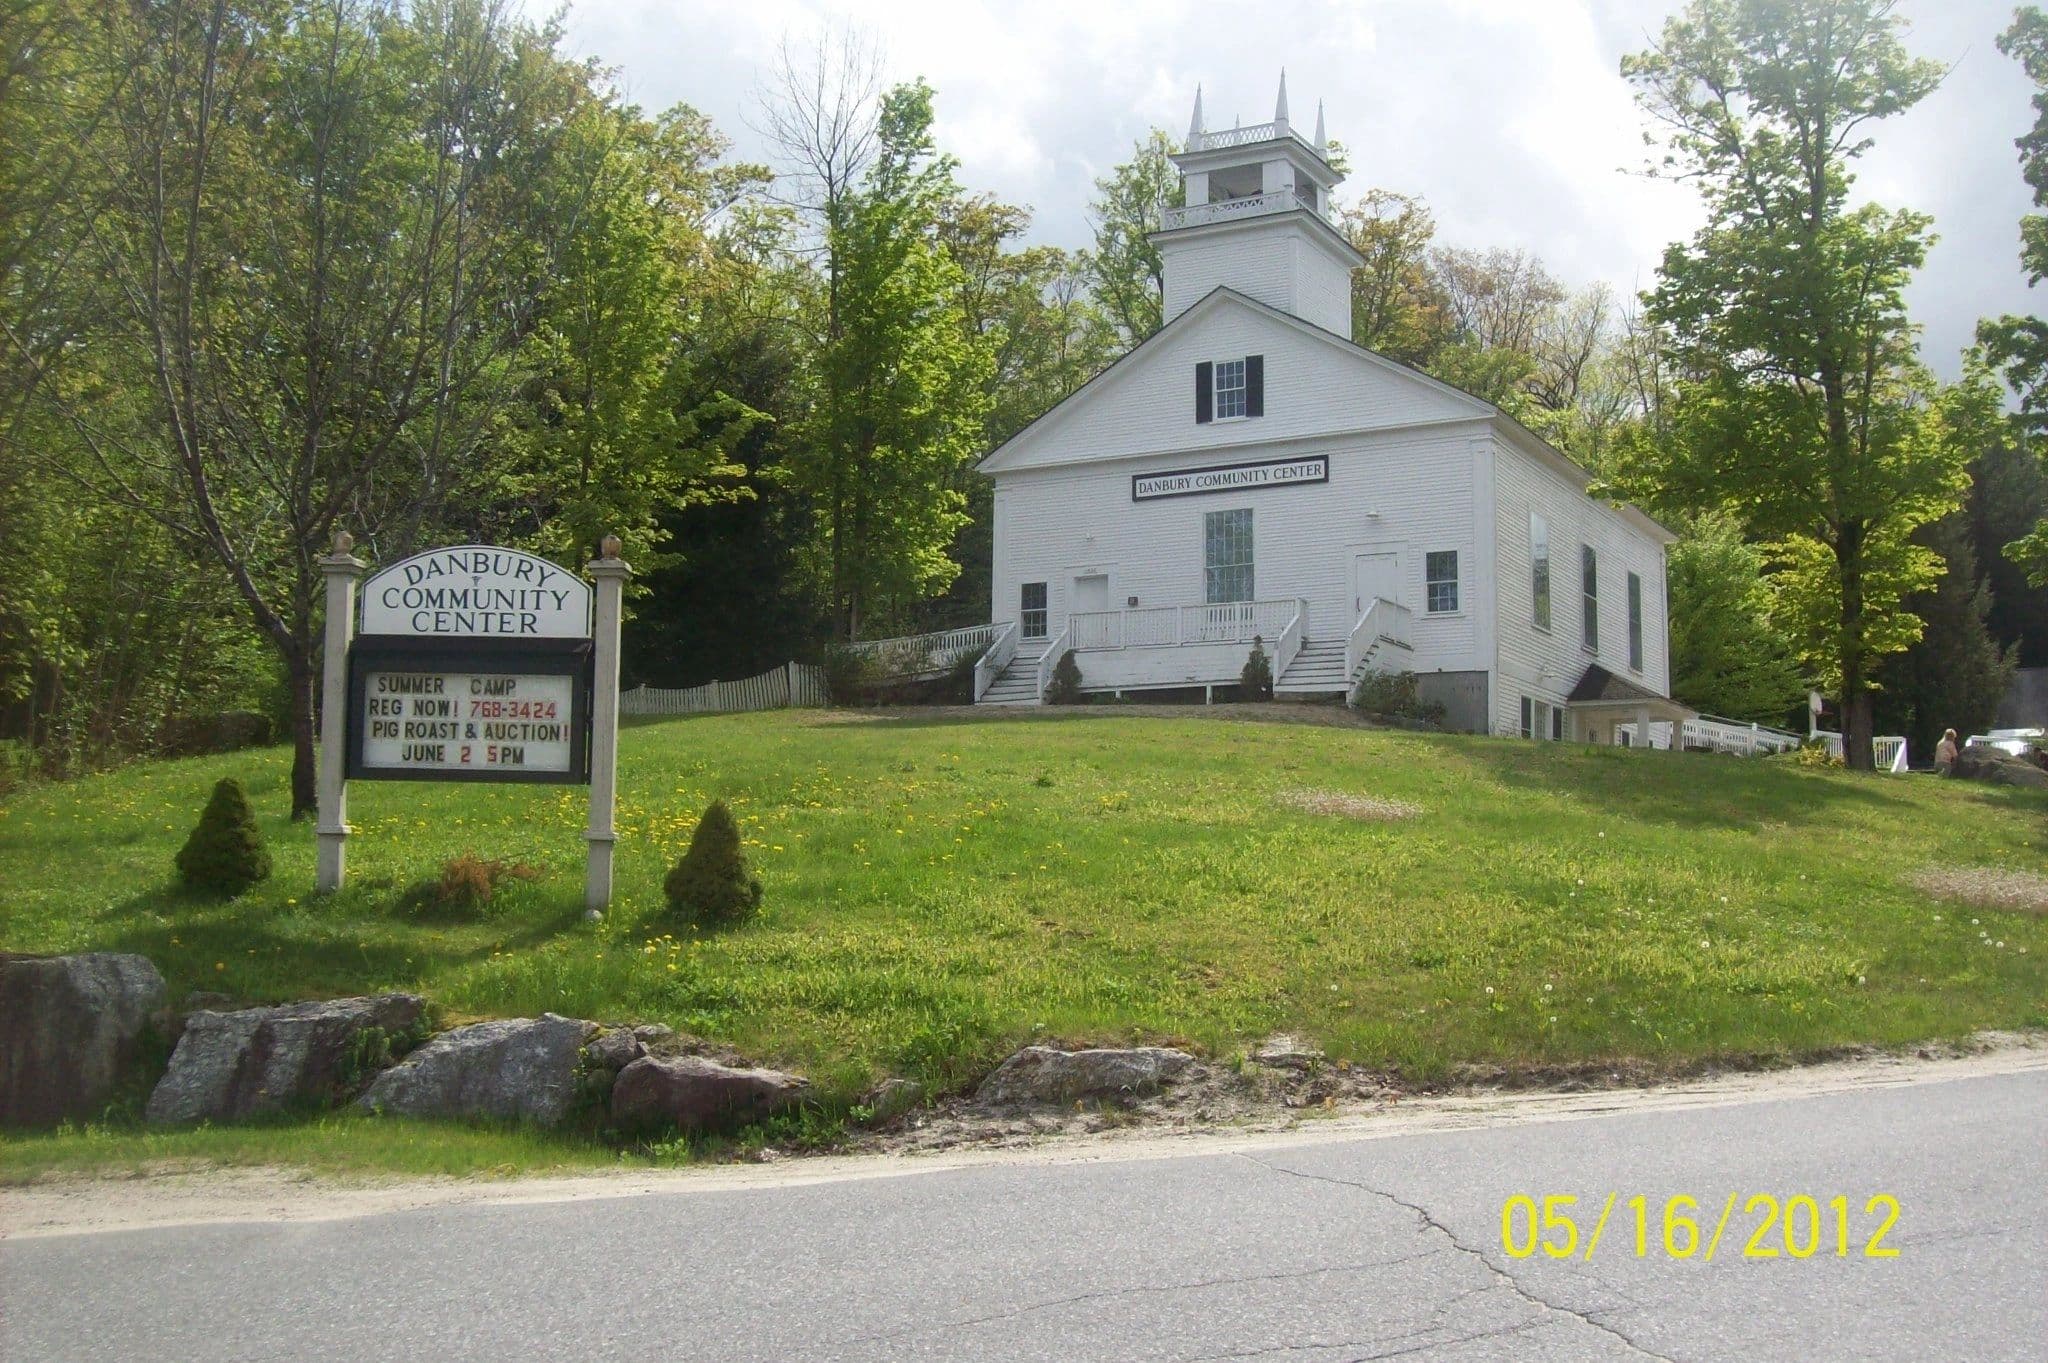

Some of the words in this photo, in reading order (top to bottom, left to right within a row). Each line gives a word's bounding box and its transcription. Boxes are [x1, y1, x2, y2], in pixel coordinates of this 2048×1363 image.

[1138, 477, 1192, 494] DANBURY
[1195, 469, 1269, 487] COMMUNITY
[1273, 463, 1322, 479] CENTER
[403, 552, 557, 588] DANBURY
[382, 587, 570, 611] COMMUNITY
[412, 611, 538, 633] CENTER
[377, 677, 444, 694] SUMMER
[470, 679, 516, 695] CAMP
[369, 700, 402, 716] REG
[414, 700, 459, 718] NOW!
[470, 701, 557, 719] 768-3424
[372, 722, 399, 738] PIG
[405, 722, 460, 740] ROAST
[465, 723, 477, 739] &
[484, 723, 569, 742] AUCTION!
[402, 745, 445, 763] JUNE
[460, 746, 472, 763] 2
